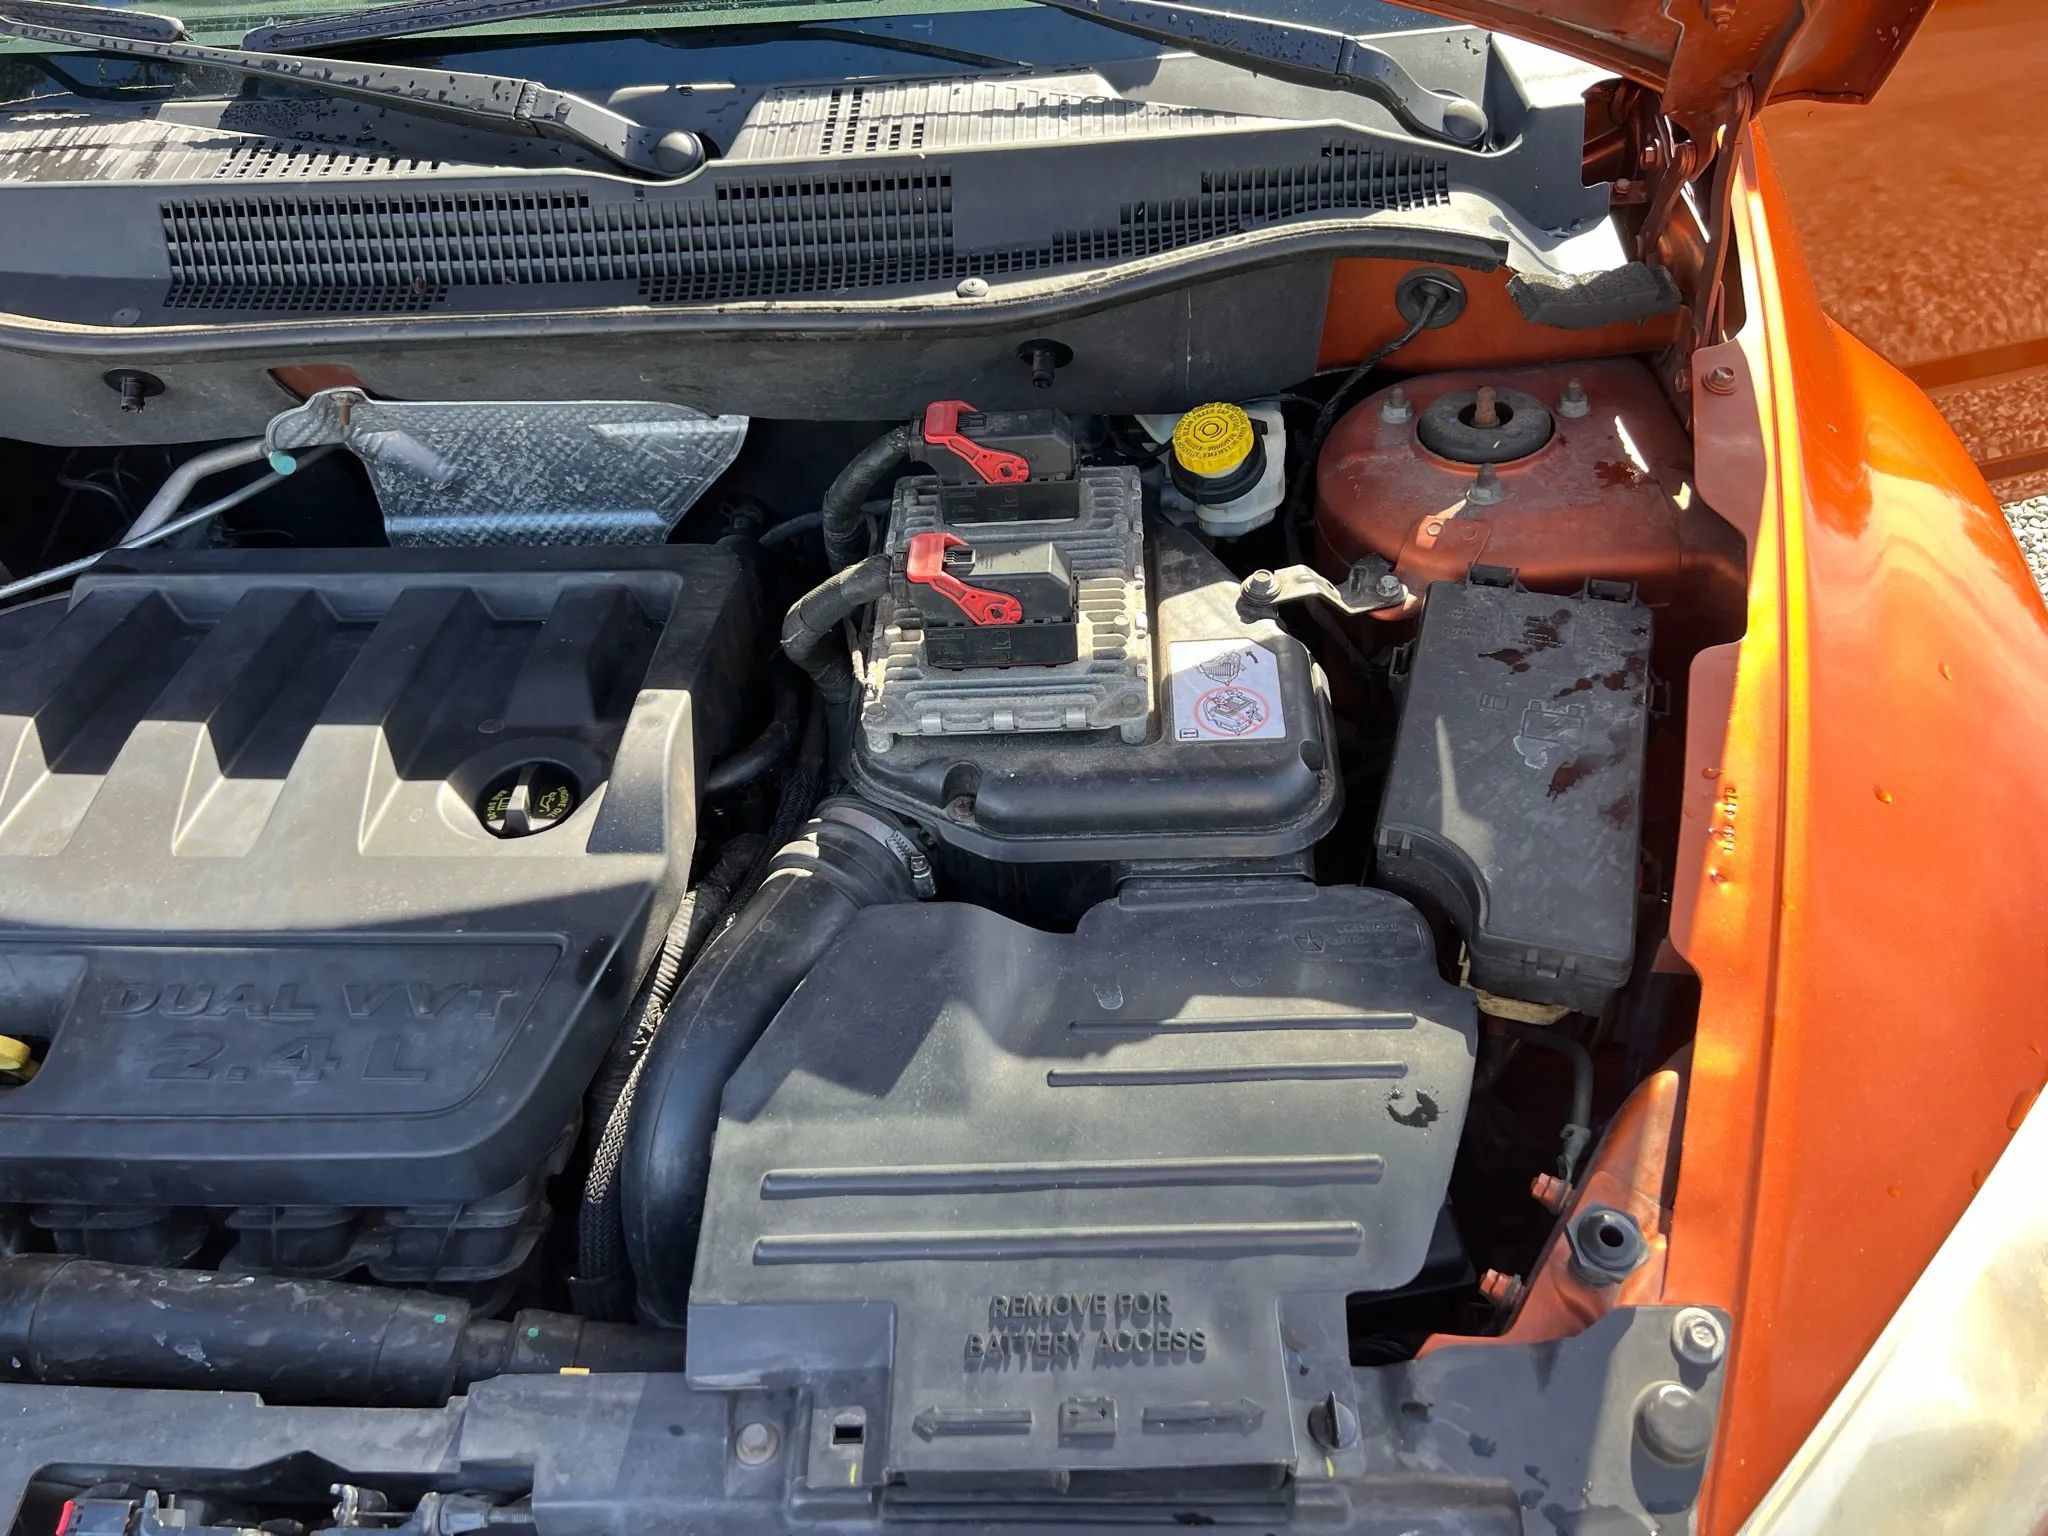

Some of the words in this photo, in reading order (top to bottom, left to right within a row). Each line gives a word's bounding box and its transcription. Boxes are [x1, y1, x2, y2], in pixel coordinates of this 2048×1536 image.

[101, 982, 318, 1019] DUAL
[342, 982, 518, 1022] VVT
[146, 1032, 339, 1084] 2.4
[361, 1032, 431, 1083] L
[990, 1291, 1107, 1320] REMOVE
[1115, 1290, 1172, 1318] FOR
[965, 1330, 1085, 1361] BATTERY
[1097, 1328, 1207, 1353] ACCESS
